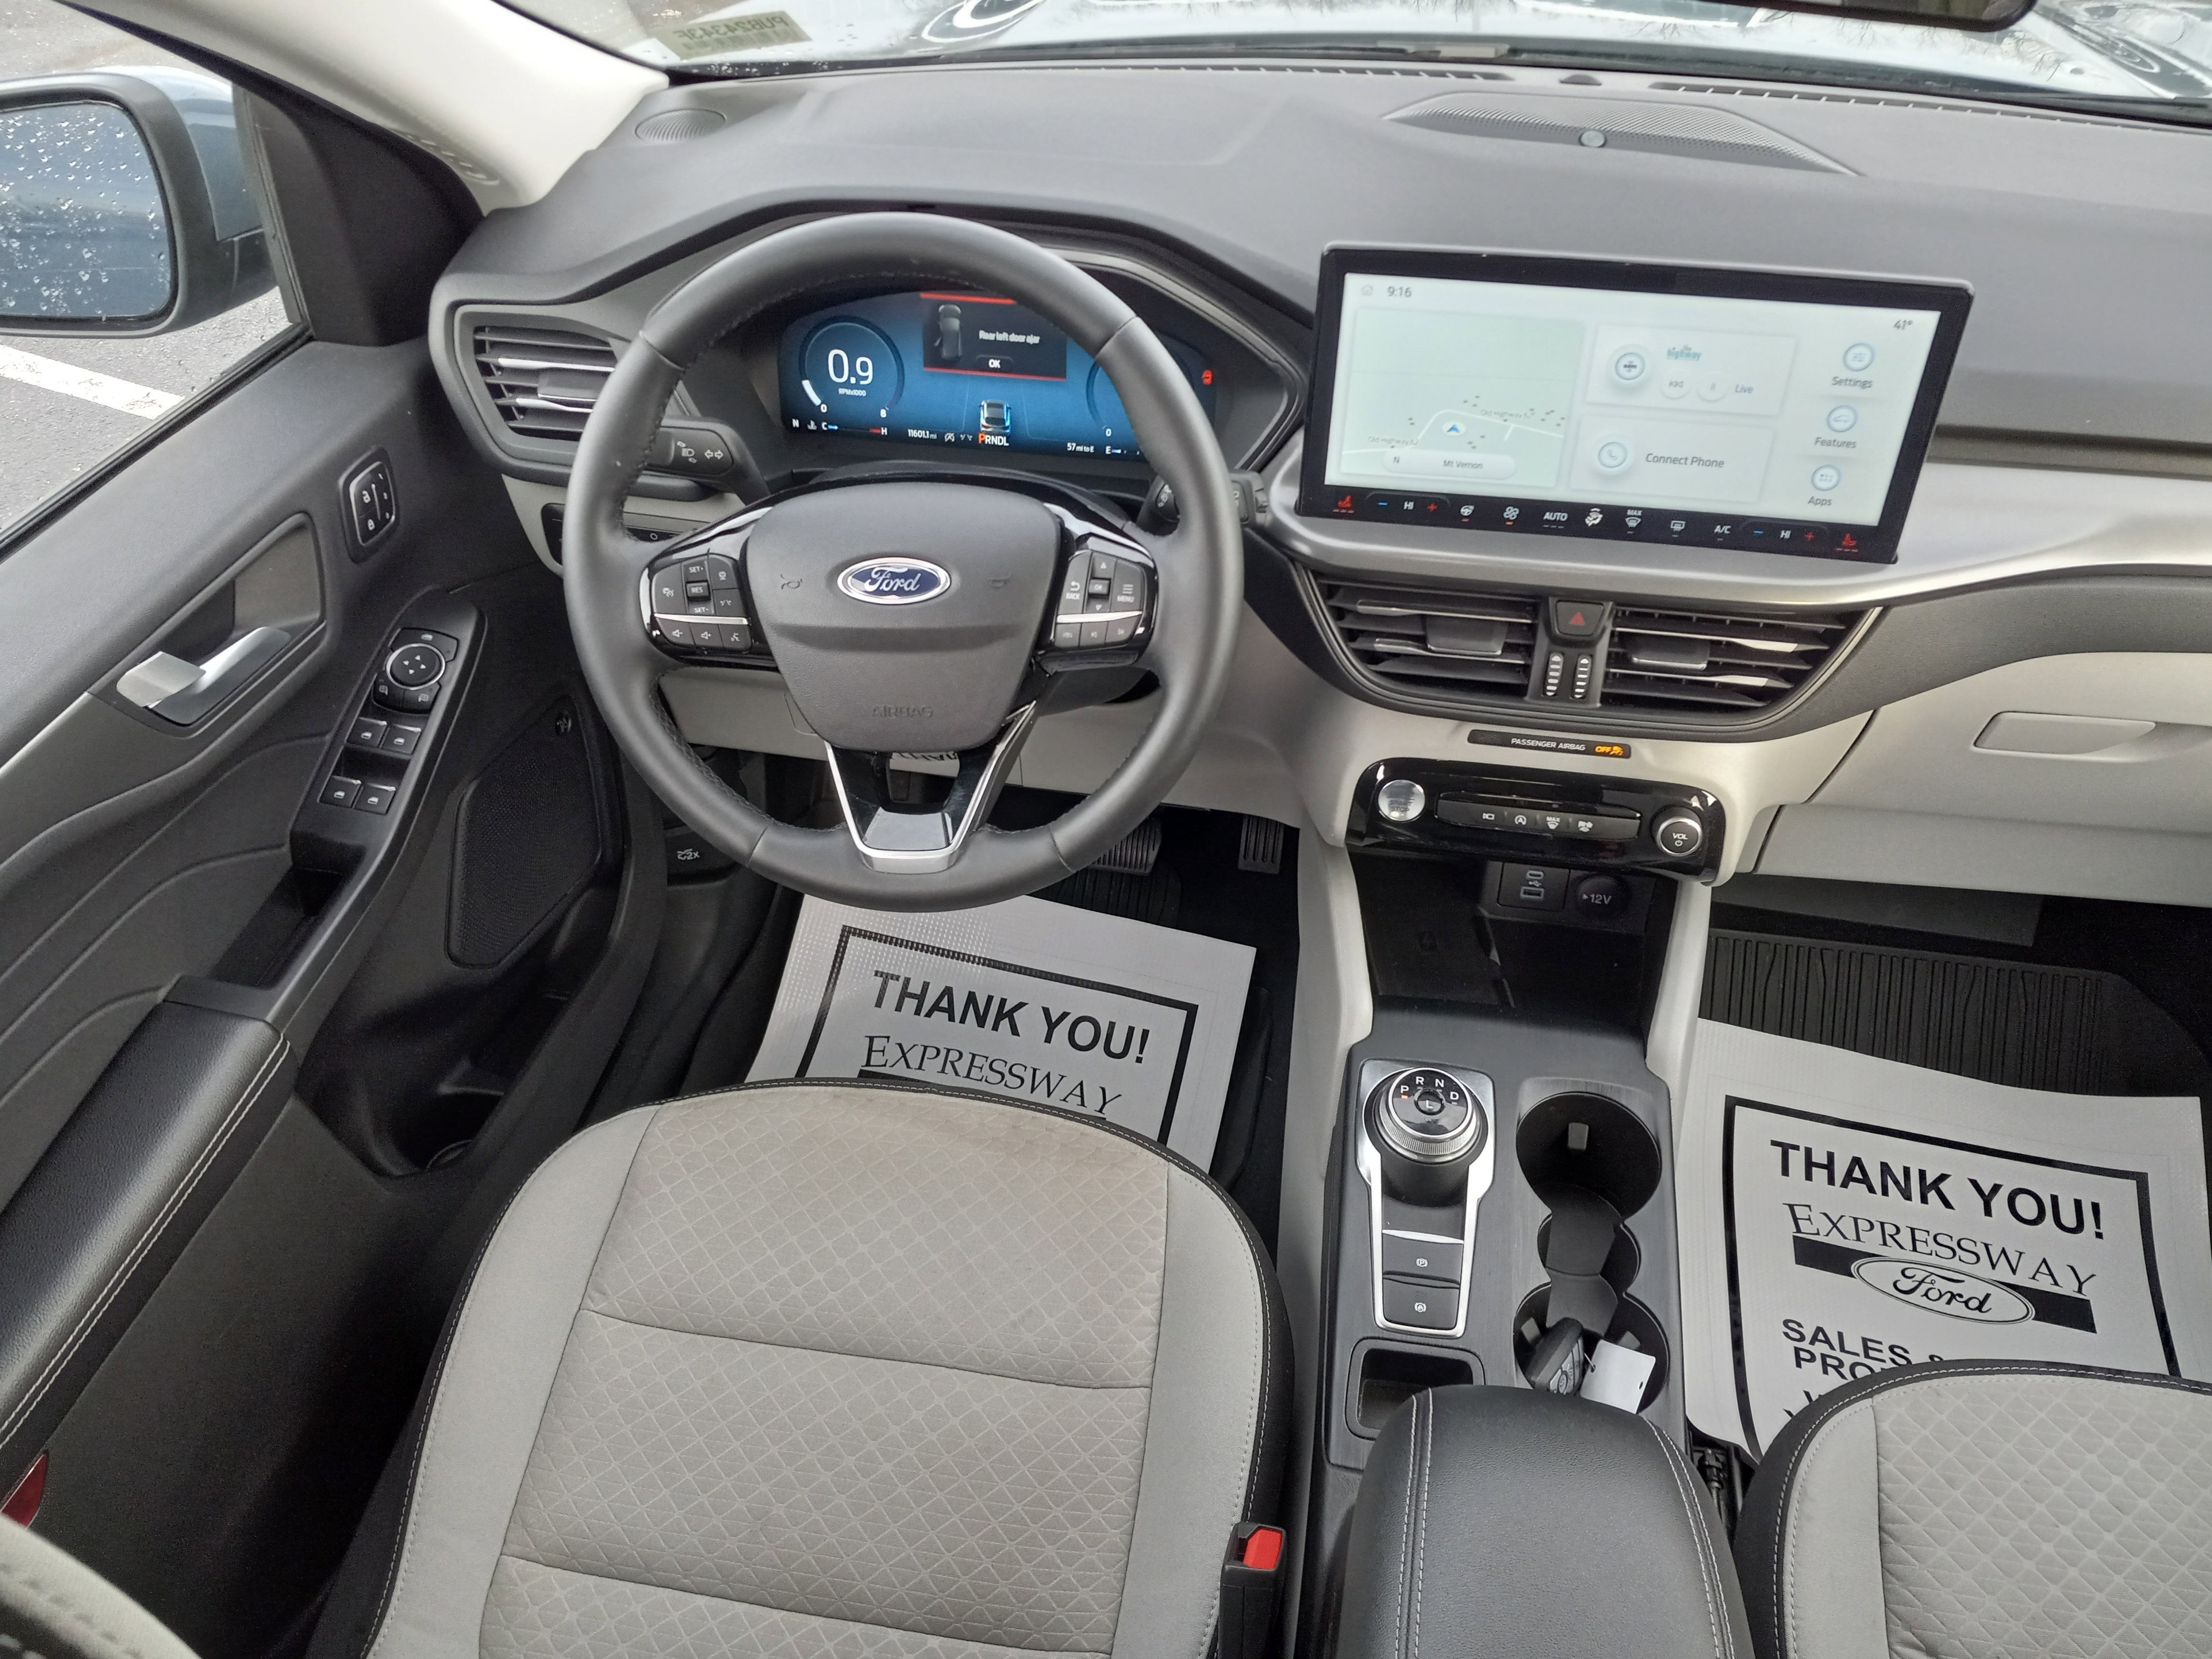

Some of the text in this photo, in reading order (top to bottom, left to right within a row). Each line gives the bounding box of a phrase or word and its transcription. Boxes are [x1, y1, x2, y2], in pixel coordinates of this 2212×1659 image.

[1387, 286, 1412, 298] 9:16
[828, 349, 873, 385] 0.9
[989, 359, 1001, 368] OK
[1832, 376, 1874, 389] Settings
[1735, 385, 1754, 394] Live
[820, 404, 828, 413] 0
[792, 418, 799, 427] N
[821, 422, 827, 430] C
[880, 427, 888, 435] H
[1106, 428, 1112, 436] 0
[978, 432, 1010, 446] PRNDL
[1815, 437, 1857, 449] Features
[1067, 442, 1076, 451] 57
[1106, 445, 1111, 454] E
[1455, 460, 1484, 469] Vernon
[1646, 453, 1724, 468] Connect Phone
[1404, 501, 1414, 510] HI
[1808, 497, 1832, 507] Apps
[1543, 512, 1568, 521] AUTO
[1714, 525, 1731, 534] A/C
[1780, 530, 1791, 539] HI
[864, 567, 922, 592] Ford
[872, 705, 934, 718] AIRBAG
[1511, 738, 1557, 748] PASSENGER
[1558, 743, 1587, 751] AIRBAG
[1589, 893, 1612, 904] 12V
[873, 969, 1151, 1064] THANK YOU!
[861, 1034, 1122, 1116] EXPRESSWAY
[1400, 1076, 1459, 1100] P R N D
[1425, 1100, 1433, 1108] L
[1770, 1139, 2106, 1240] THANK YOU!
[1782, 1202, 2097, 1297] EXPRESSWAY
[1893, 1266, 1992, 1314] Ford
[1782, 1318, 1913, 1367] SALES
[1793, 1346, 1893, 1381] PRO
